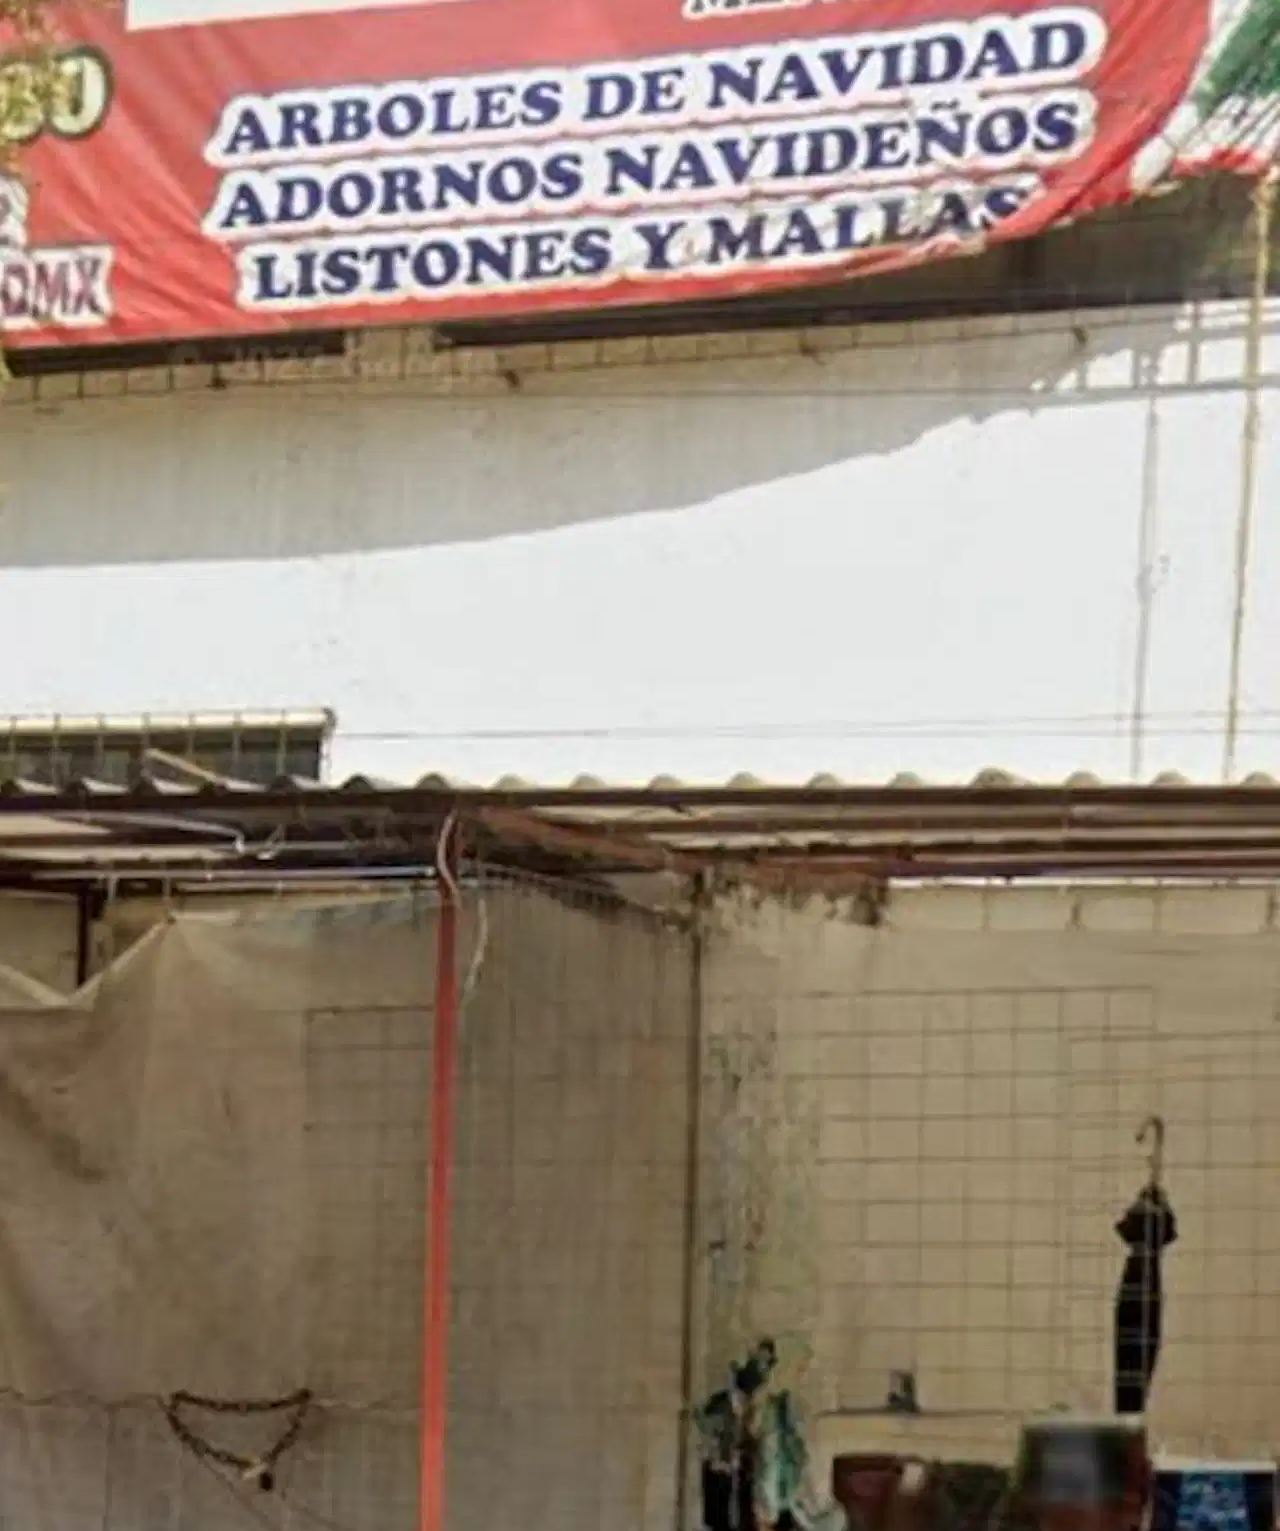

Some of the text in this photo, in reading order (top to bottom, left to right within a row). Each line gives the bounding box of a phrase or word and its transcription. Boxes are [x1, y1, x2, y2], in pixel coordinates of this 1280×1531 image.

[222, 20, 1087, 155] ARBOLES DE NAVIDAD
[218, 100, 1080, 230] ADORNOS NAVIDEÑOS
[252, 186, 1030, 302] LISTONES Y MALLAS
